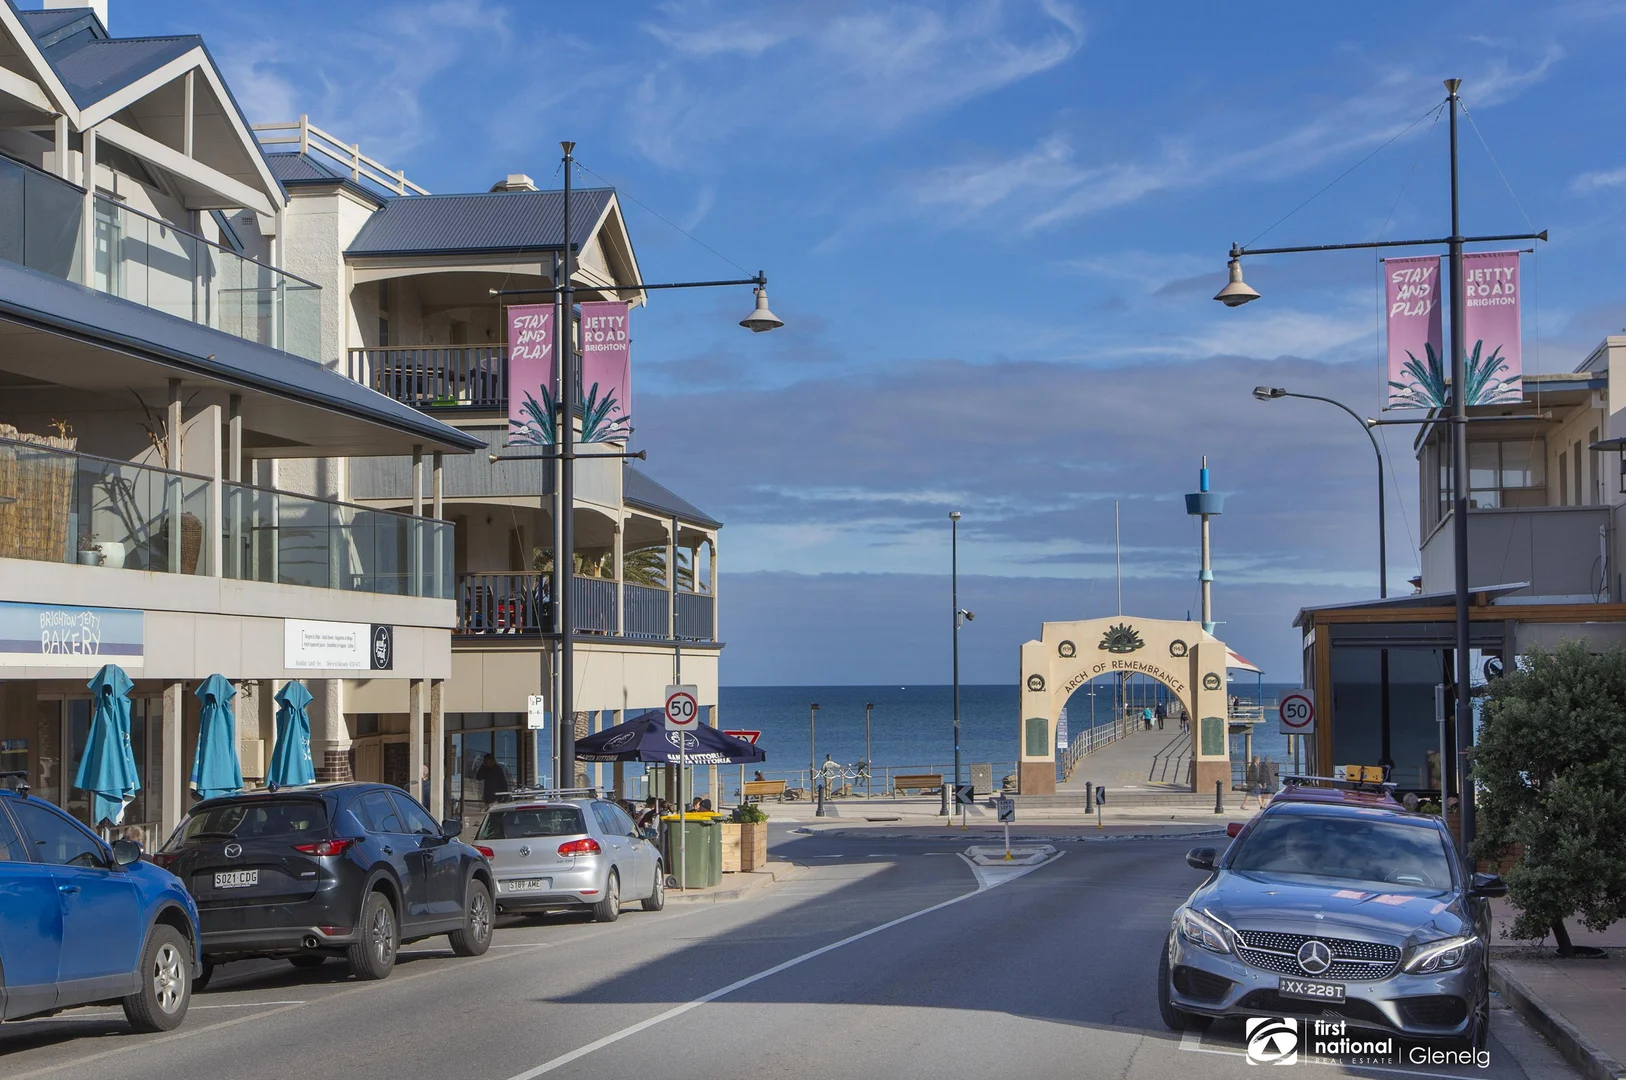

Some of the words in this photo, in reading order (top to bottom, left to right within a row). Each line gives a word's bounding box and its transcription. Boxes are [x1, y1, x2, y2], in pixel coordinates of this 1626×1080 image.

[1392, 266, 1434, 283] STAY
[1467, 267, 1515, 282] JETTY
[1396, 284, 1431, 300] AND
[1467, 283, 1515, 297] ROAD
[1389, 299, 1437, 318] PLAY
[1467, 297, 1515, 307] BRIGHTON
[513, 314, 549, 329] STAY
[585, 316, 625, 329] JETTY
[517, 330, 546, 345] AND
[585, 330, 625, 342] ROAD
[511, 344, 552, 360] PLAY
[585, 343, 626, 352] BRIGHTON
[40, 610, 77, 629] BRIGHTON
[77, 610, 100, 630] JETTY
[41, 626, 101, 655] BAKERY
[1064, 671, 1089, 694] ARCH
[1092, 663, 1107, 673] OF
[1111, 660, 1185, 693] REMEMBRANCE
[671, 700, 693, 717] 50
[1287, 703, 1308, 719] 50
[690, 752, 725, 760] VITTORIA
